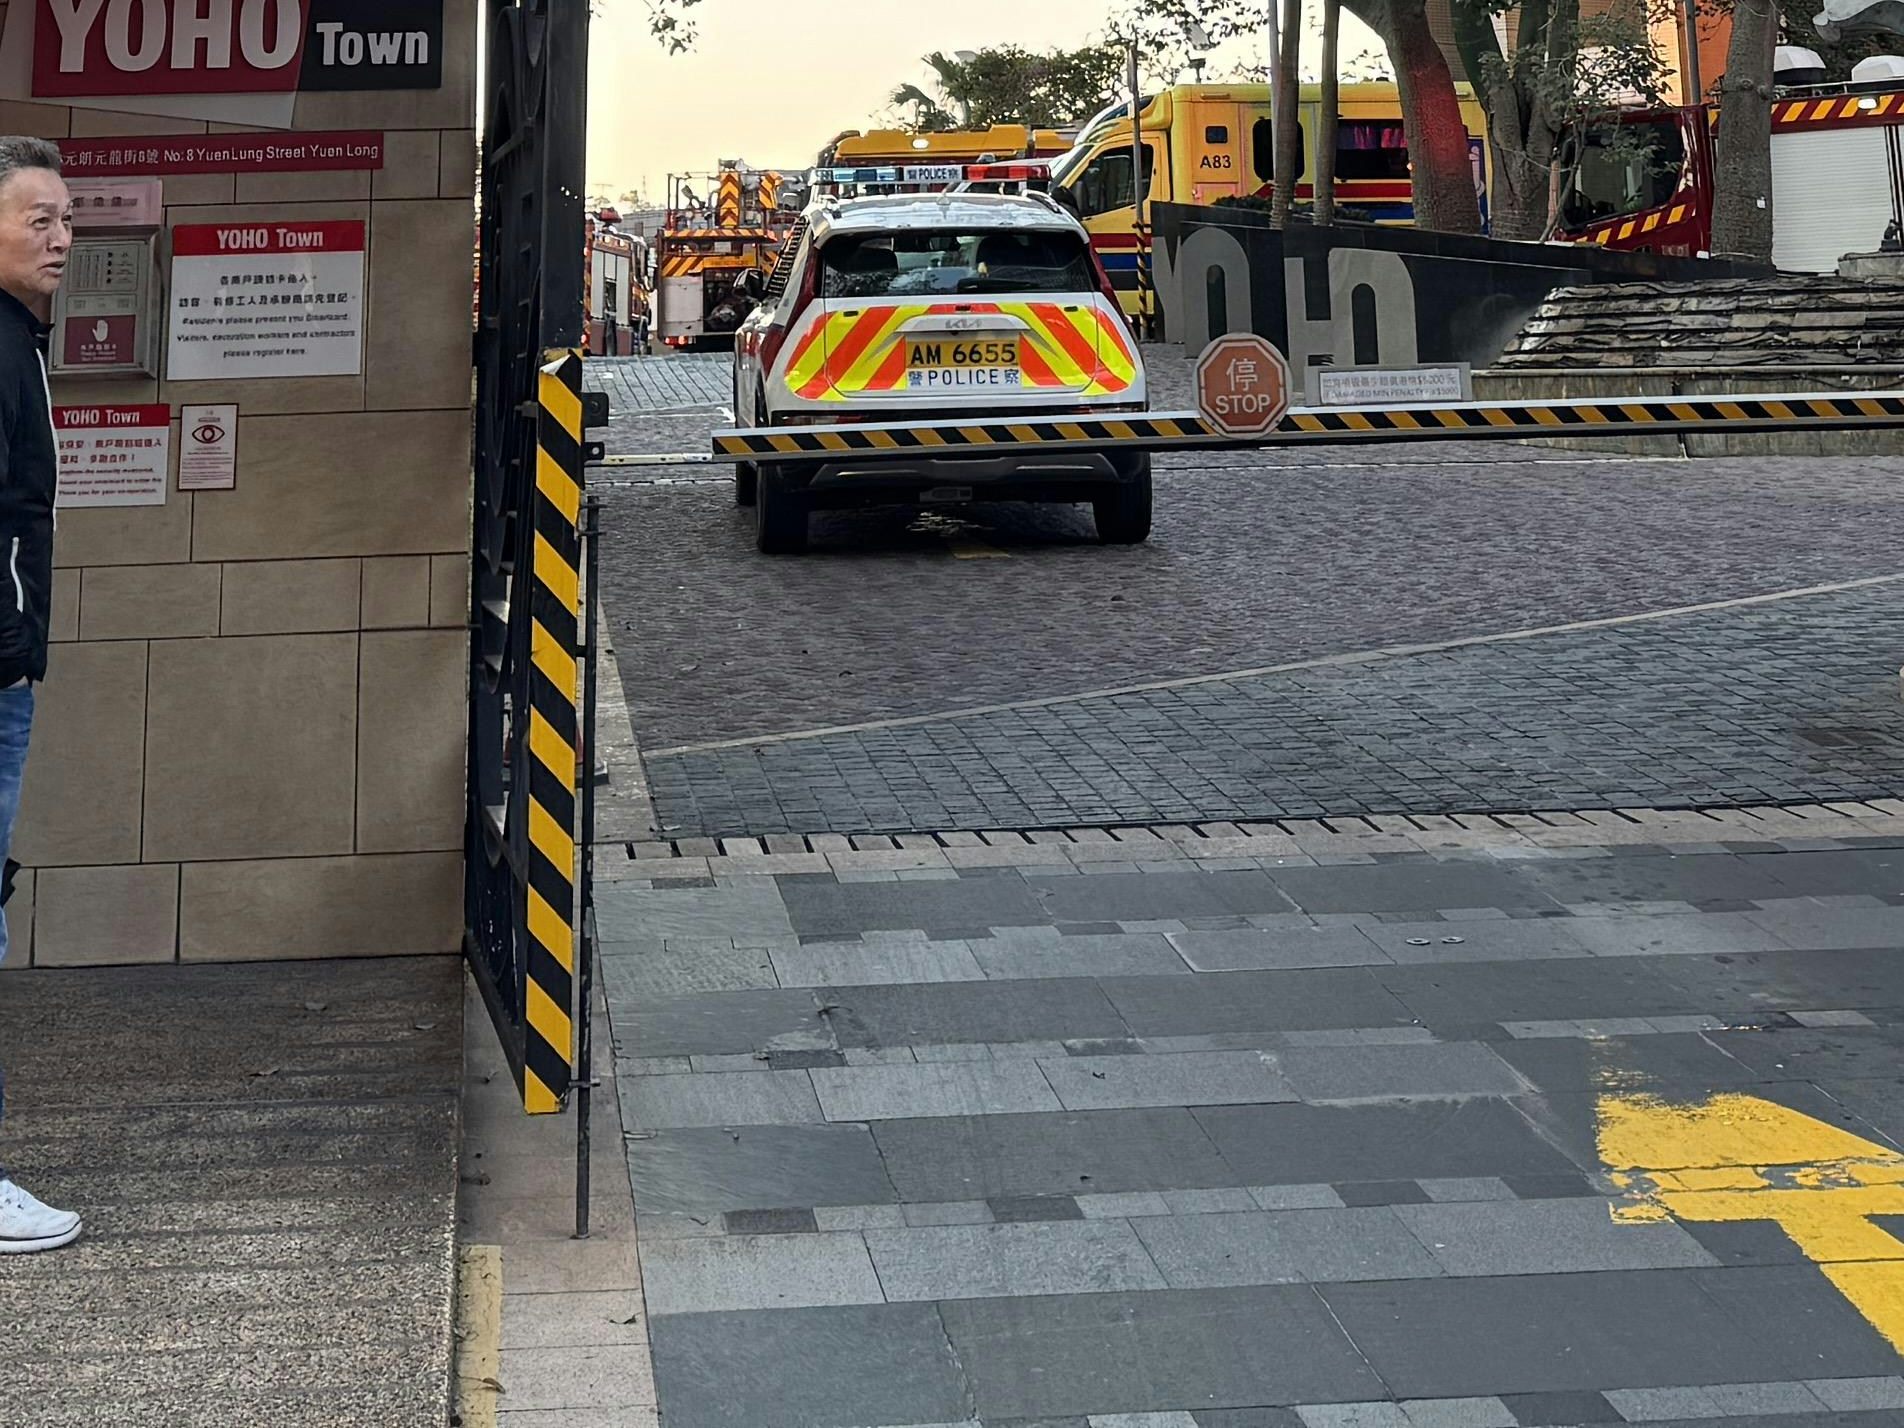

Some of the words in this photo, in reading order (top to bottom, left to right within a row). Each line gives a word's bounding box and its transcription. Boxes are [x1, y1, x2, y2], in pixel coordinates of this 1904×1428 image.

[316, 22, 429, 68] Town
[60, 149, 159, 167] 元朗元龍街8號
[186, 148, 194, 162] 8
[266, 146, 305, 159] Street
[310, 144, 343, 157] Yuen
[346, 143, 379, 159] Long
[1199, 154, 1232, 169] A83
[918, 168, 946, 180] POLICE
[217, 228, 269, 249] YOHO
[276, 228, 324, 247] Town
[225, 315, 254, 326] please
[292, 330, 307, 339] and
[910, 344, 941, 365] AM
[953, 343, 1016, 364] 6655
[908, 371, 923, 386] 警
[928, 369, 999, 386] POLICE
[1004, 369, 1019, 384] 察
[1226, 358, 1258, 392] 停
[1215, 394, 1271, 415] STOP
[63, 410, 100, 425] YOHO
[105, 409, 140, 424] Town
